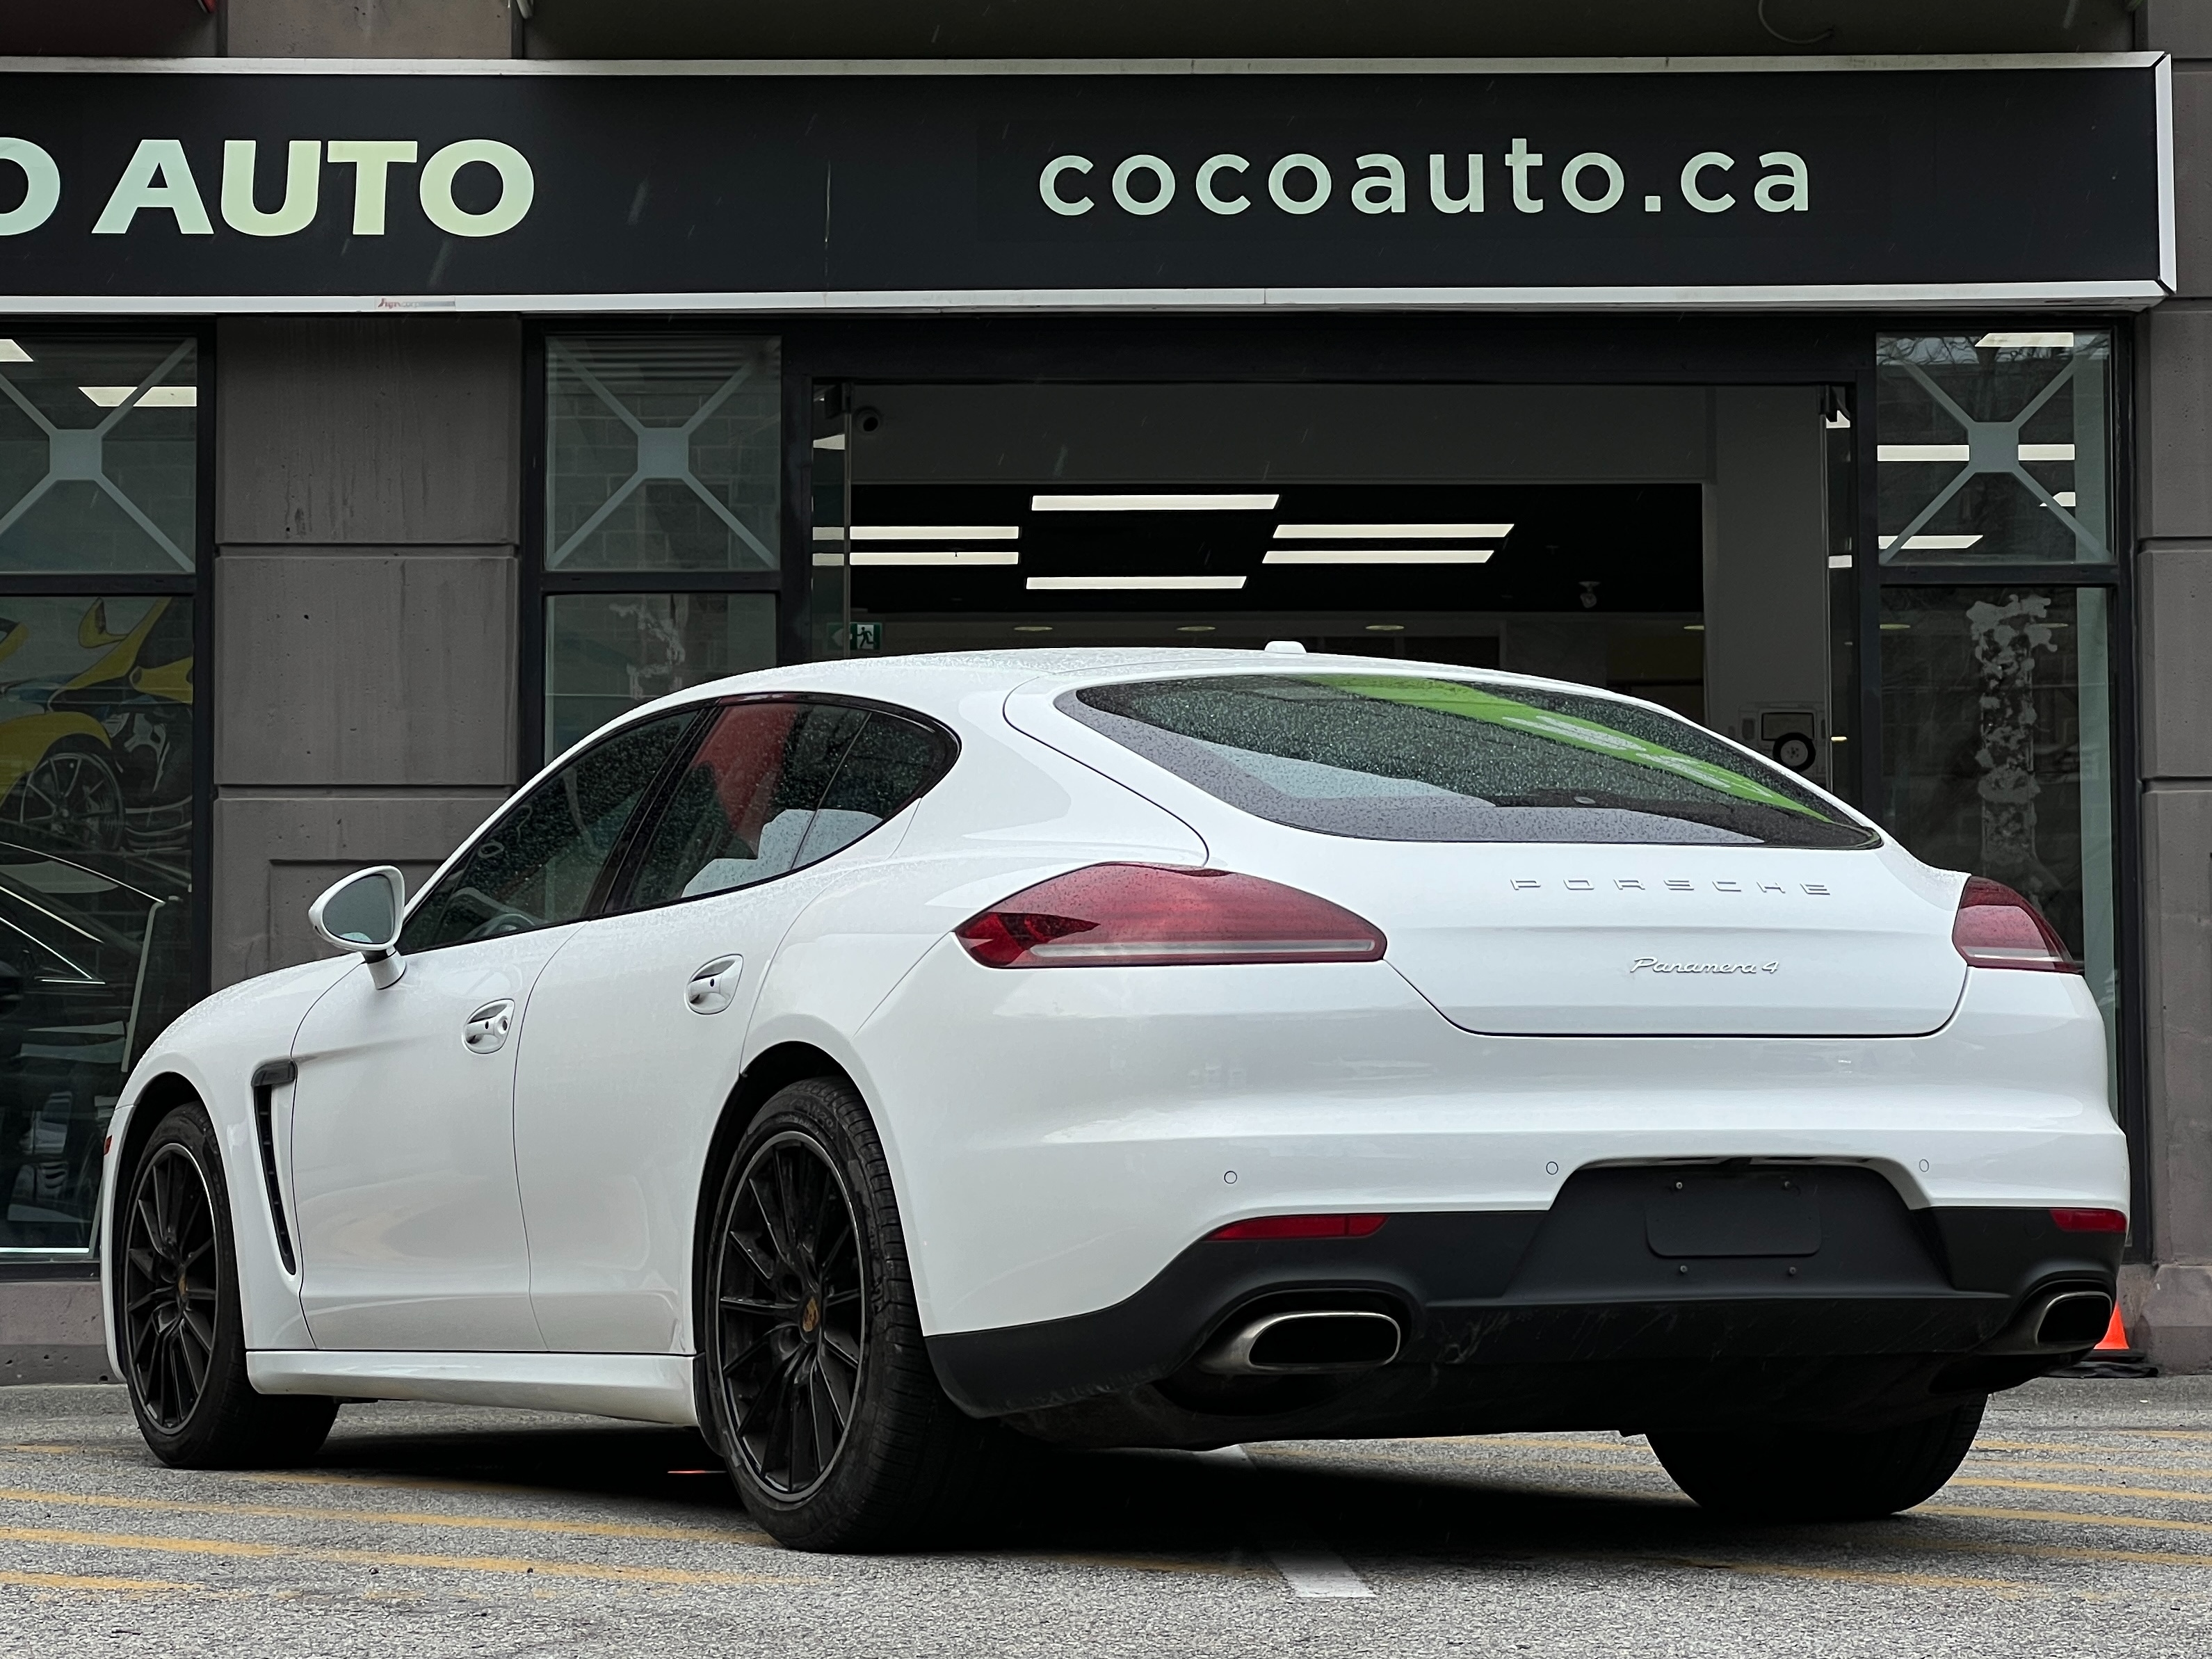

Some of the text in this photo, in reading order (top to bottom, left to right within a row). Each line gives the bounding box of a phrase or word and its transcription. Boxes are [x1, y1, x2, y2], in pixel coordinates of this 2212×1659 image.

[91, 139, 535, 237] AUTO
[1039, 138, 1809, 216] cocoauto.ca
[1510, 878, 1831, 896] PORSCHE
[1629, 956, 1779, 974] Panamera 4
